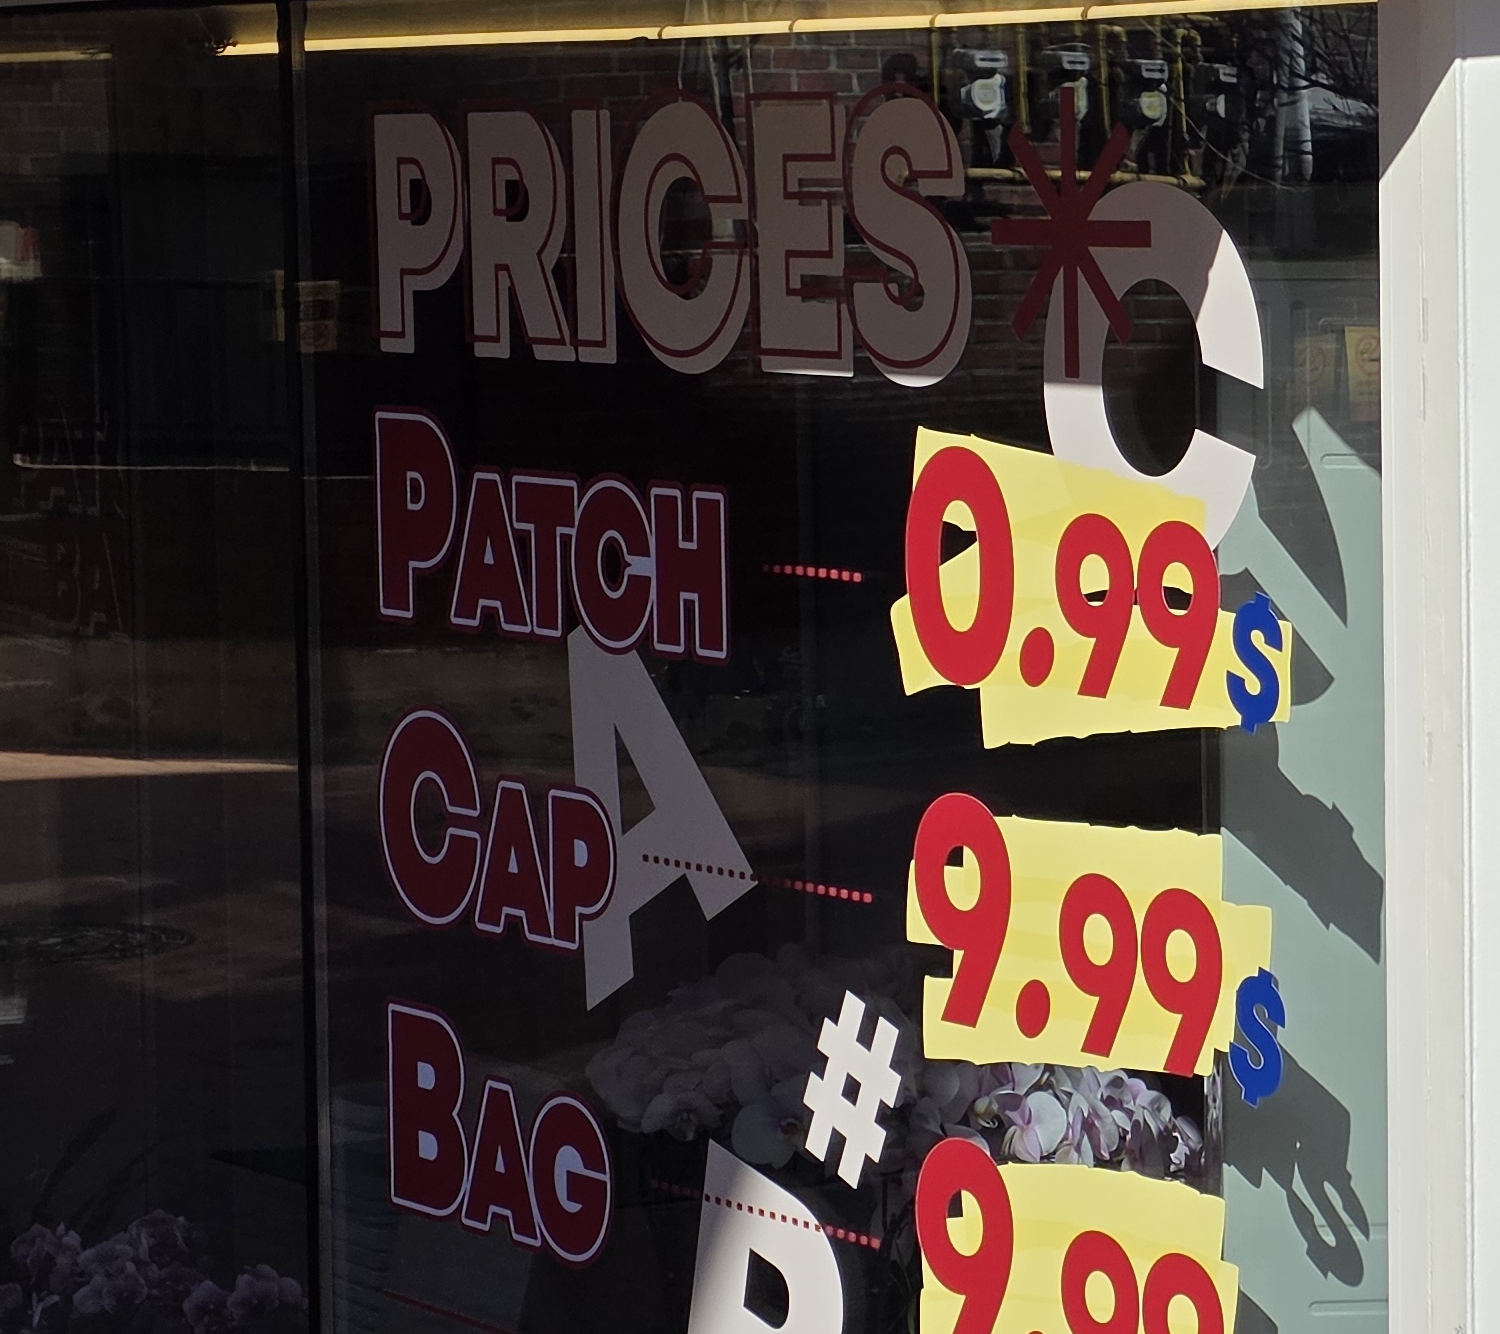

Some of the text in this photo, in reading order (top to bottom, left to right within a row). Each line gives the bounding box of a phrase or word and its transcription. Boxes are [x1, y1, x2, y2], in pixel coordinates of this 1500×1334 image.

[370, 83, 972, 388] PRICES
[371, 405, 730, 665] PATCH
[378, 705, 619, 954] CAP
[385, 999, 614, 1267] BAG
